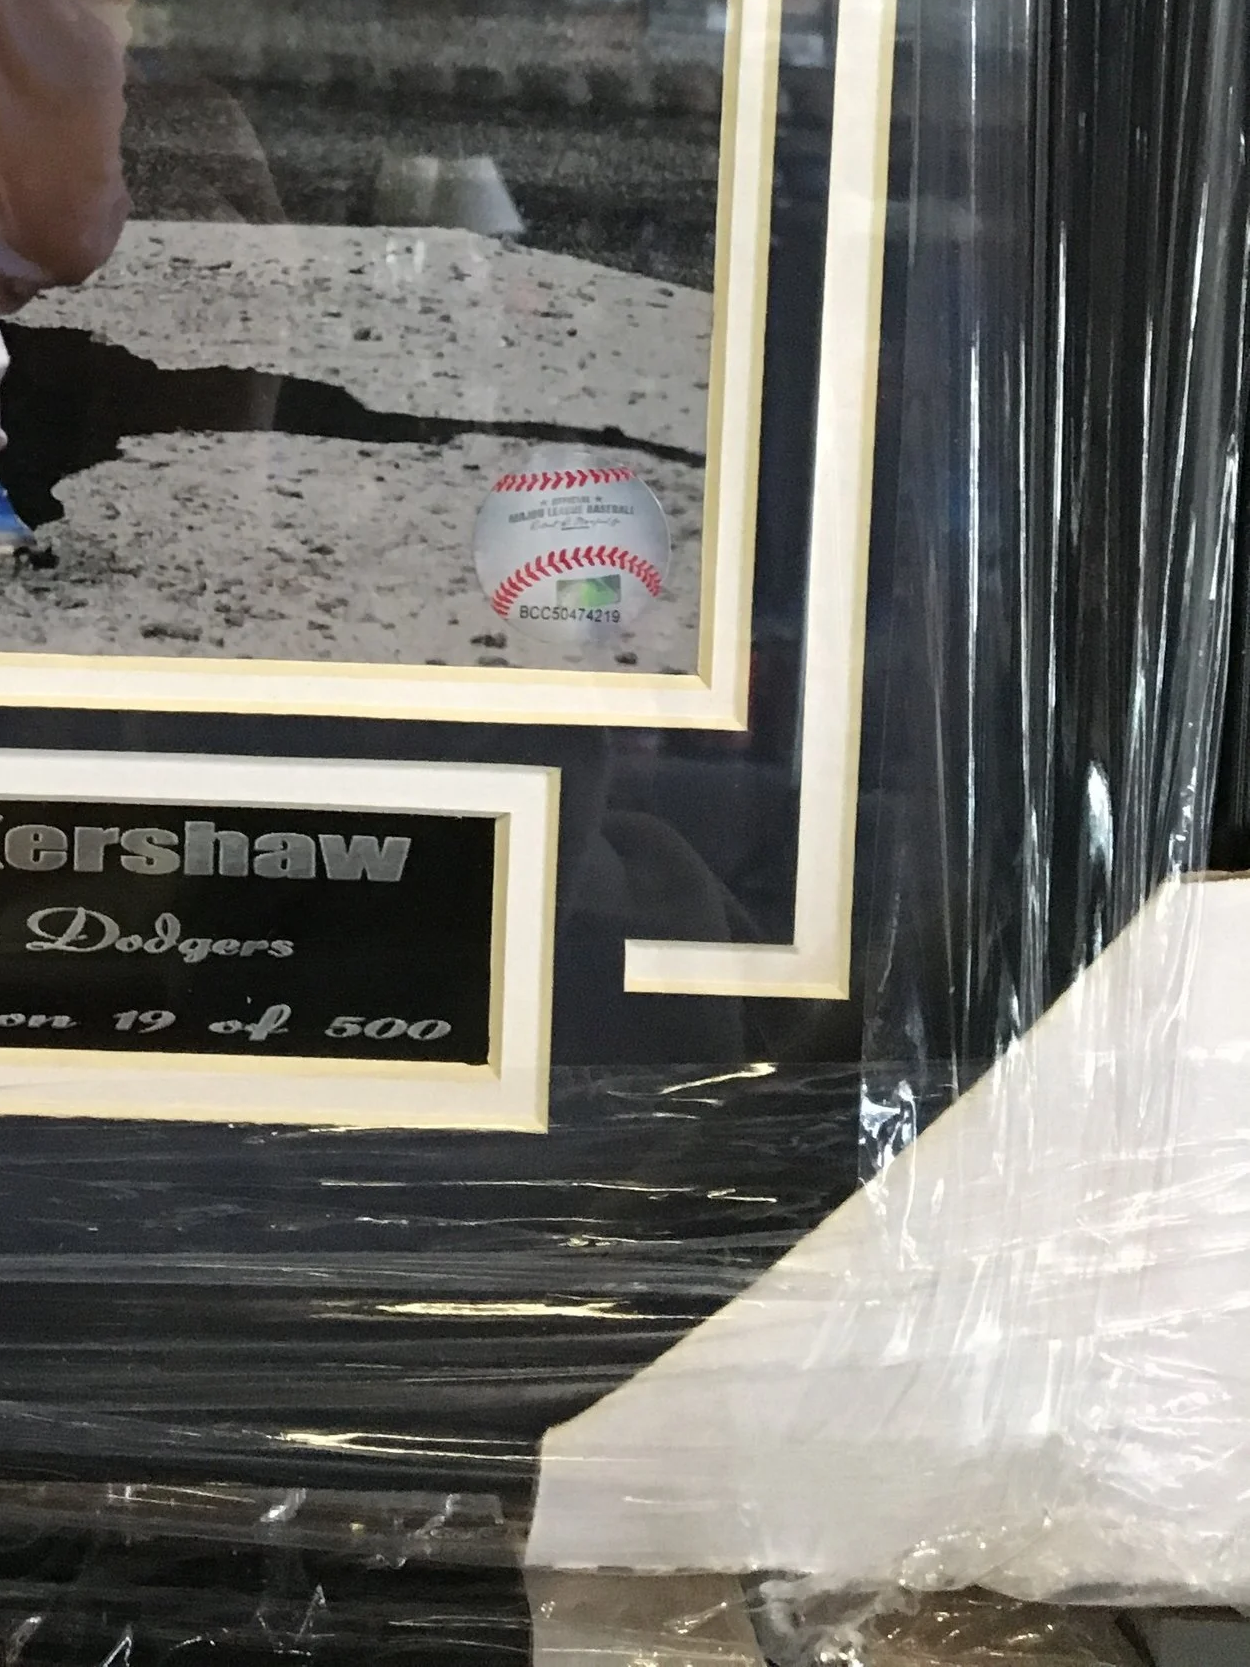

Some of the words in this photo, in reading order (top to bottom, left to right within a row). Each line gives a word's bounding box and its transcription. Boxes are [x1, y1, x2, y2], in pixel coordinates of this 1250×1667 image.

[508, 508, 546, 524] MAJOR
[586, 504, 635, 516] BASEBALL
[519, 604, 621, 624] BCC50474219
[25, 906, 295, 964] Dodgers
[112, 1009, 177, 1035] 19
[207, 1002, 293, 1041] of
[324, 1015, 453, 1042] 500
